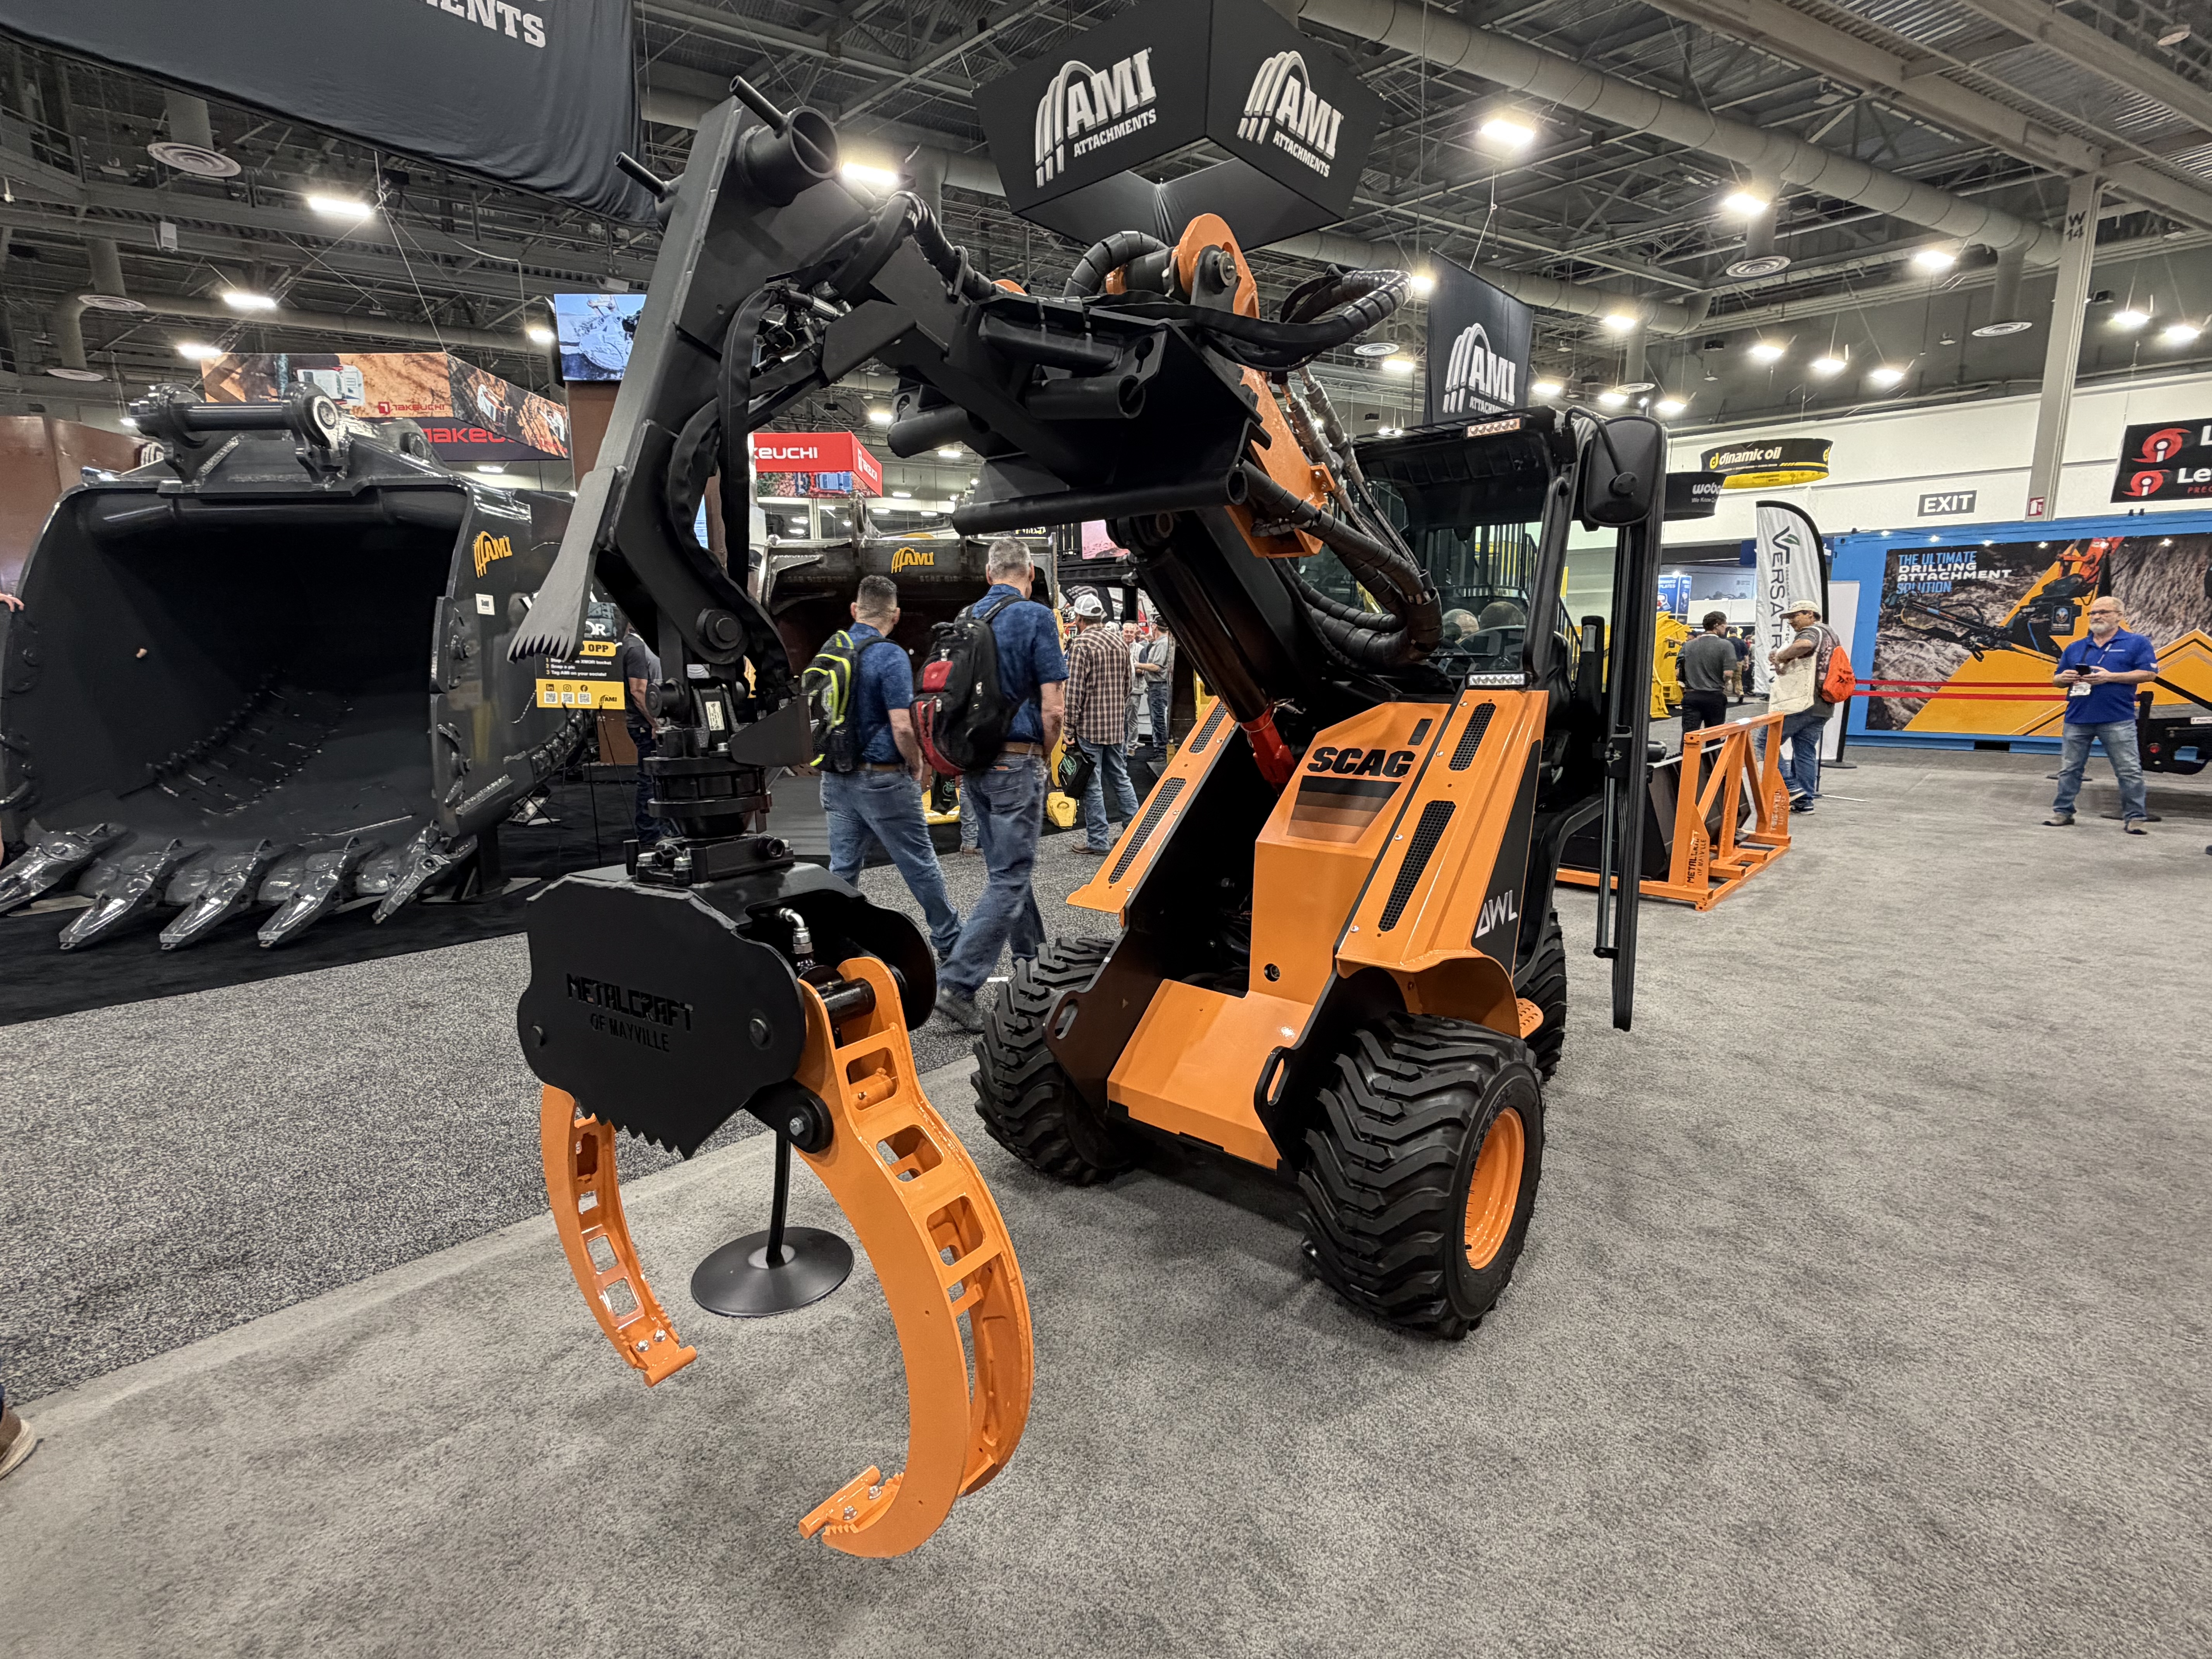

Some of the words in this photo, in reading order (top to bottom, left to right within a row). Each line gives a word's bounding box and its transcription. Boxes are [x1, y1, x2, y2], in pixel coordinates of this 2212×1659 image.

[1073, 108, 1157, 158] ATTACHMENTS
[1273, 130, 1330, 178] ATTACHMENTS
[2068, 211, 2086, 227] W
[1719, 448, 1764, 465] dinamic
[1765, 447, 1783, 460] oil
[2177, 467, 2212, 484] Le
[1923, 494, 1973, 513] EXIT
[1898, 554, 1919, 565] THE
[1922, 551, 1978, 564] ULTIMATE
[1897, 569, 2012, 582] ATTACHMENT
[1899, 562, 1977, 574] DRILLING
[588, 644, 609, 653] OPP
[1307, 747, 1416, 778] SCAG
[567, 973, 693, 1032] METALCRAFT
[590, 1013, 607, 1031] OF
[609, 1018, 670, 1052] MAYVILLE
